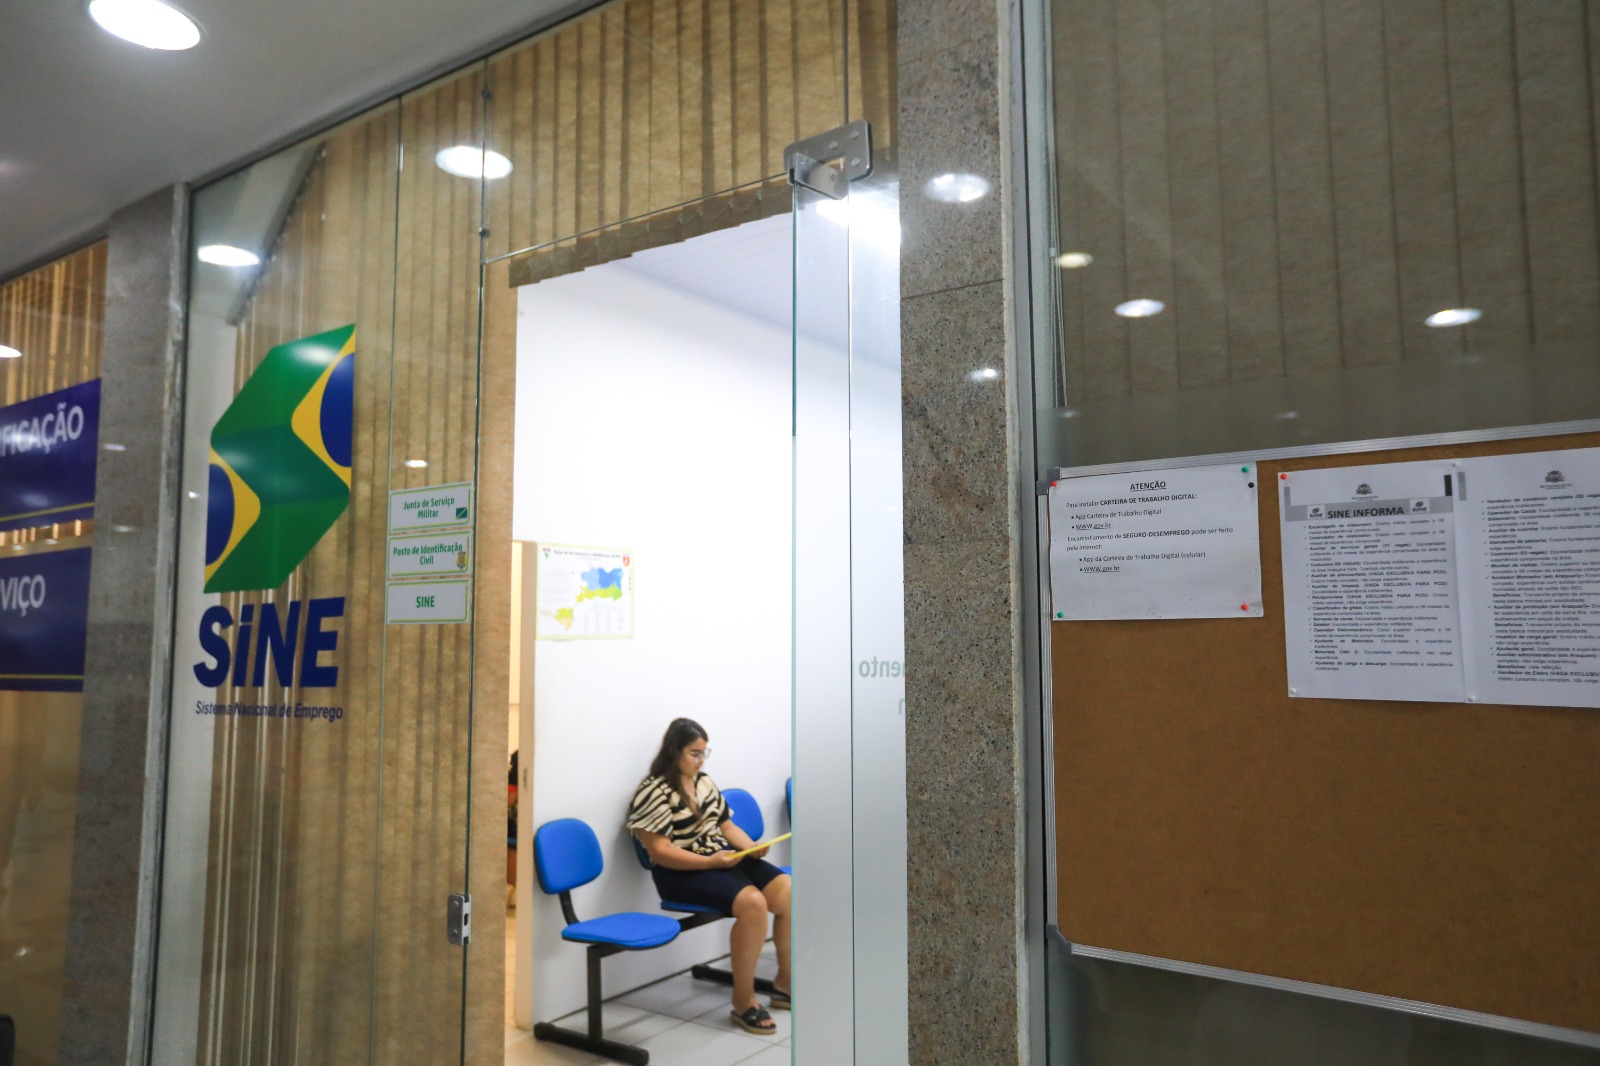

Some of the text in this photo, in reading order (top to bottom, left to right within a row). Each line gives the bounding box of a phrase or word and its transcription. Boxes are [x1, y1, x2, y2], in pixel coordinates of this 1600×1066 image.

[1130, 481, 1166, 491] ATENÇÃO
[404, 498, 454, 510] Junta de Serviço
[1100, 498, 1127, 506] CARTEIRA
[418, 509, 438, 518] Militar
[1328, 507, 1404, 519] SINE INFORMA
[1068, 534, 1113, 542] Encaminhamento
[1123, 530, 1190, 538] SEGURO-DESEMPREGO
[394, 543, 462, 556] Posto de Identificação
[420, 556, 434, 565] Civil
[0, 574, 46, 616] VIÇO
[416, 596, 435, 608] SINE
[195, 701, 343, 722] Sistema Nacional de Emprego
